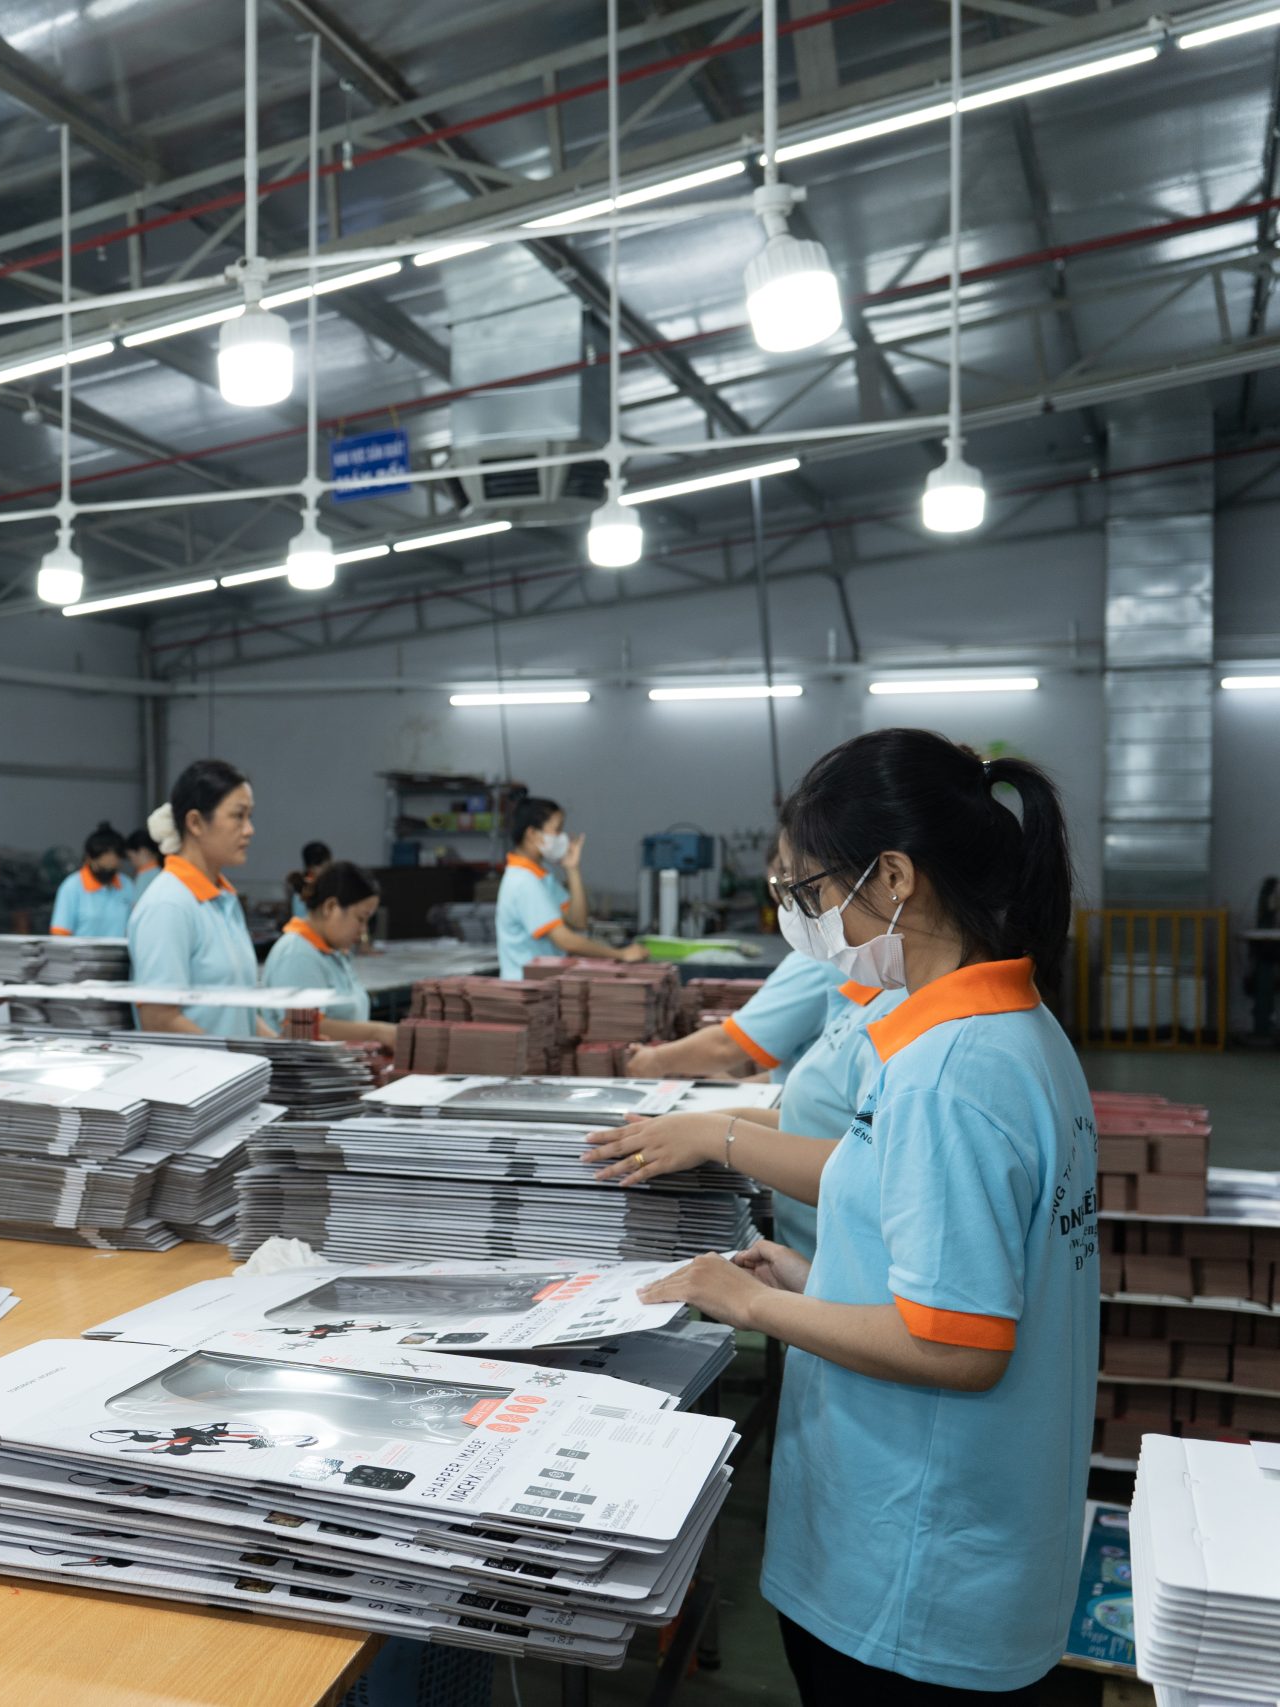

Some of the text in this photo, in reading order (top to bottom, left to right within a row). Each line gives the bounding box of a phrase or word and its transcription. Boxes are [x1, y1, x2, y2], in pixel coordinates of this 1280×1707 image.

[421, 1462, 464, 1498] SHARPER
[455, 1439, 487, 1462] IMAGE
[446, 1479, 478, 1503] MACH
